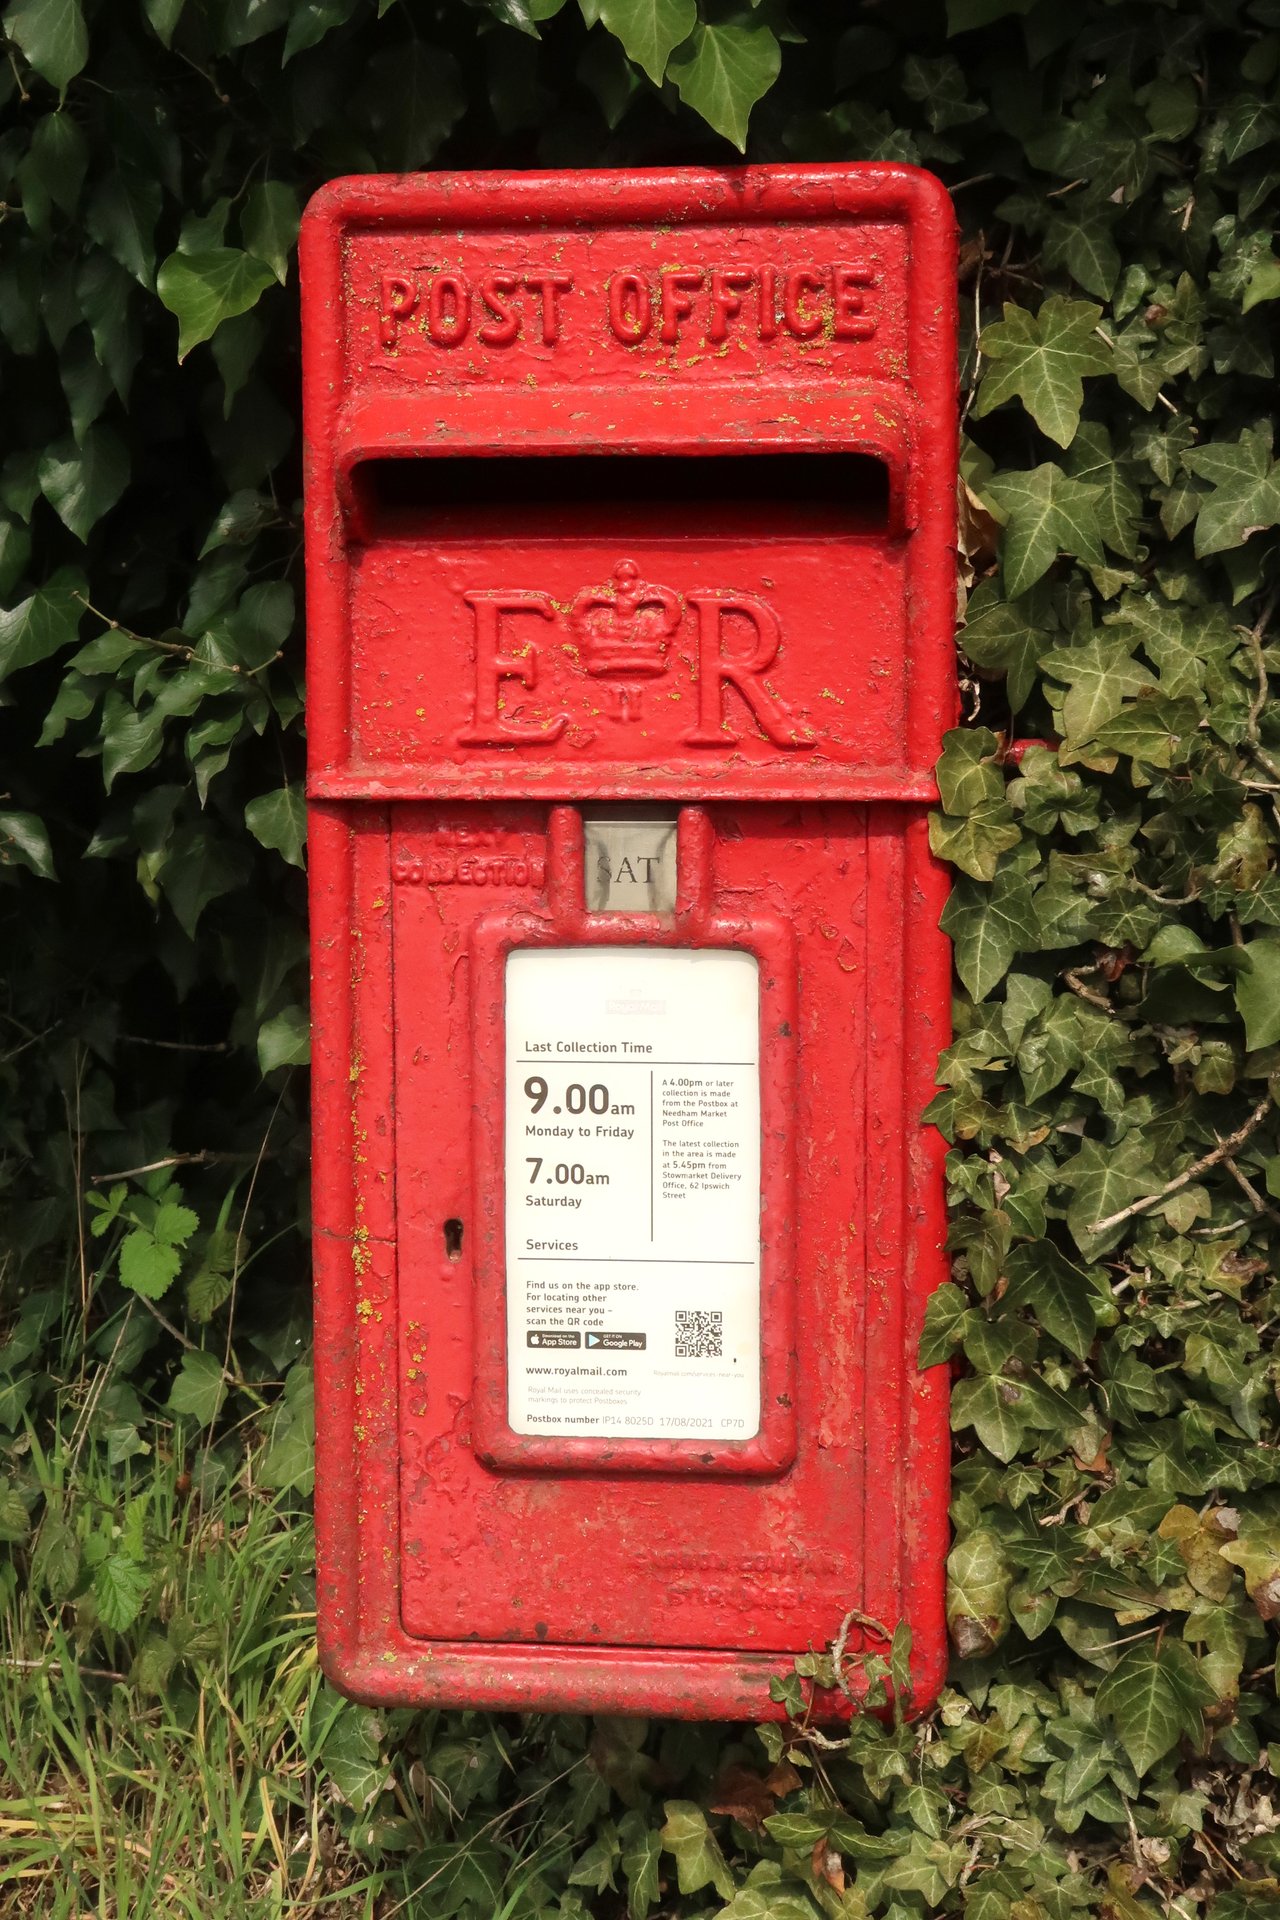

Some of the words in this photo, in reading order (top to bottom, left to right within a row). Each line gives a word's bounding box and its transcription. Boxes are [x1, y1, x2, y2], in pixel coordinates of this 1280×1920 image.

[378, 268, 574, 348] POST
[608, 263, 879, 346] OFFICE
[456, 588, 571, 749] E
[682, 588, 819, 751] R
[596, 854, 661, 885] SAT
[526, 1041, 552, 1052] Last
[557, 1041, 617, 1053] Collection
[621, 1042, 653, 1053] Time
[670, 1078, 703, 1088] 4.00pm
[526, 1125, 574, 1139] Monday
[578, 1127, 591, 1137] to
[596, 1126, 634, 1140] Friday
[673, 1161, 706, 1170] 5.45pm
[711, 1172, 742, 1181] Delivery
[702, 1183, 730, 1191] Ipswich
[526, 1195, 582, 1209] Saturday
[526, 1239, 578, 1251] Services
[527, 1281, 545, 1289] Find
[576, 1282, 591, 1290] the
[594, 1284, 611, 1292] app
[614, 1283, 639, 1291] store.
[527, 1293, 541, 1301] For
[544, 1293, 580, 1303] locating
[583, 1294, 607, 1302] other
[526, 1305, 563, 1313] services
[589, 1308, 605, 1316] you
[550, 1318, 564, 1326] the
[568, 1318, 580, 1326] QR
[583, 1318, 604, 1326] code
[542, 1339, 557, 1347] App
[602, 1339, 628, 1348] Google
[629, 1340, 643, 1348] Play
[526, 1366, 627, 1377] www.royalmail.com
[527, 1414, 562, 1423] Postbox
[565, 1416, 600, 1424] number
[660, 1418, 712, 1427] 17/08/2021
[721, 1419, 744, 1428] CP7D
